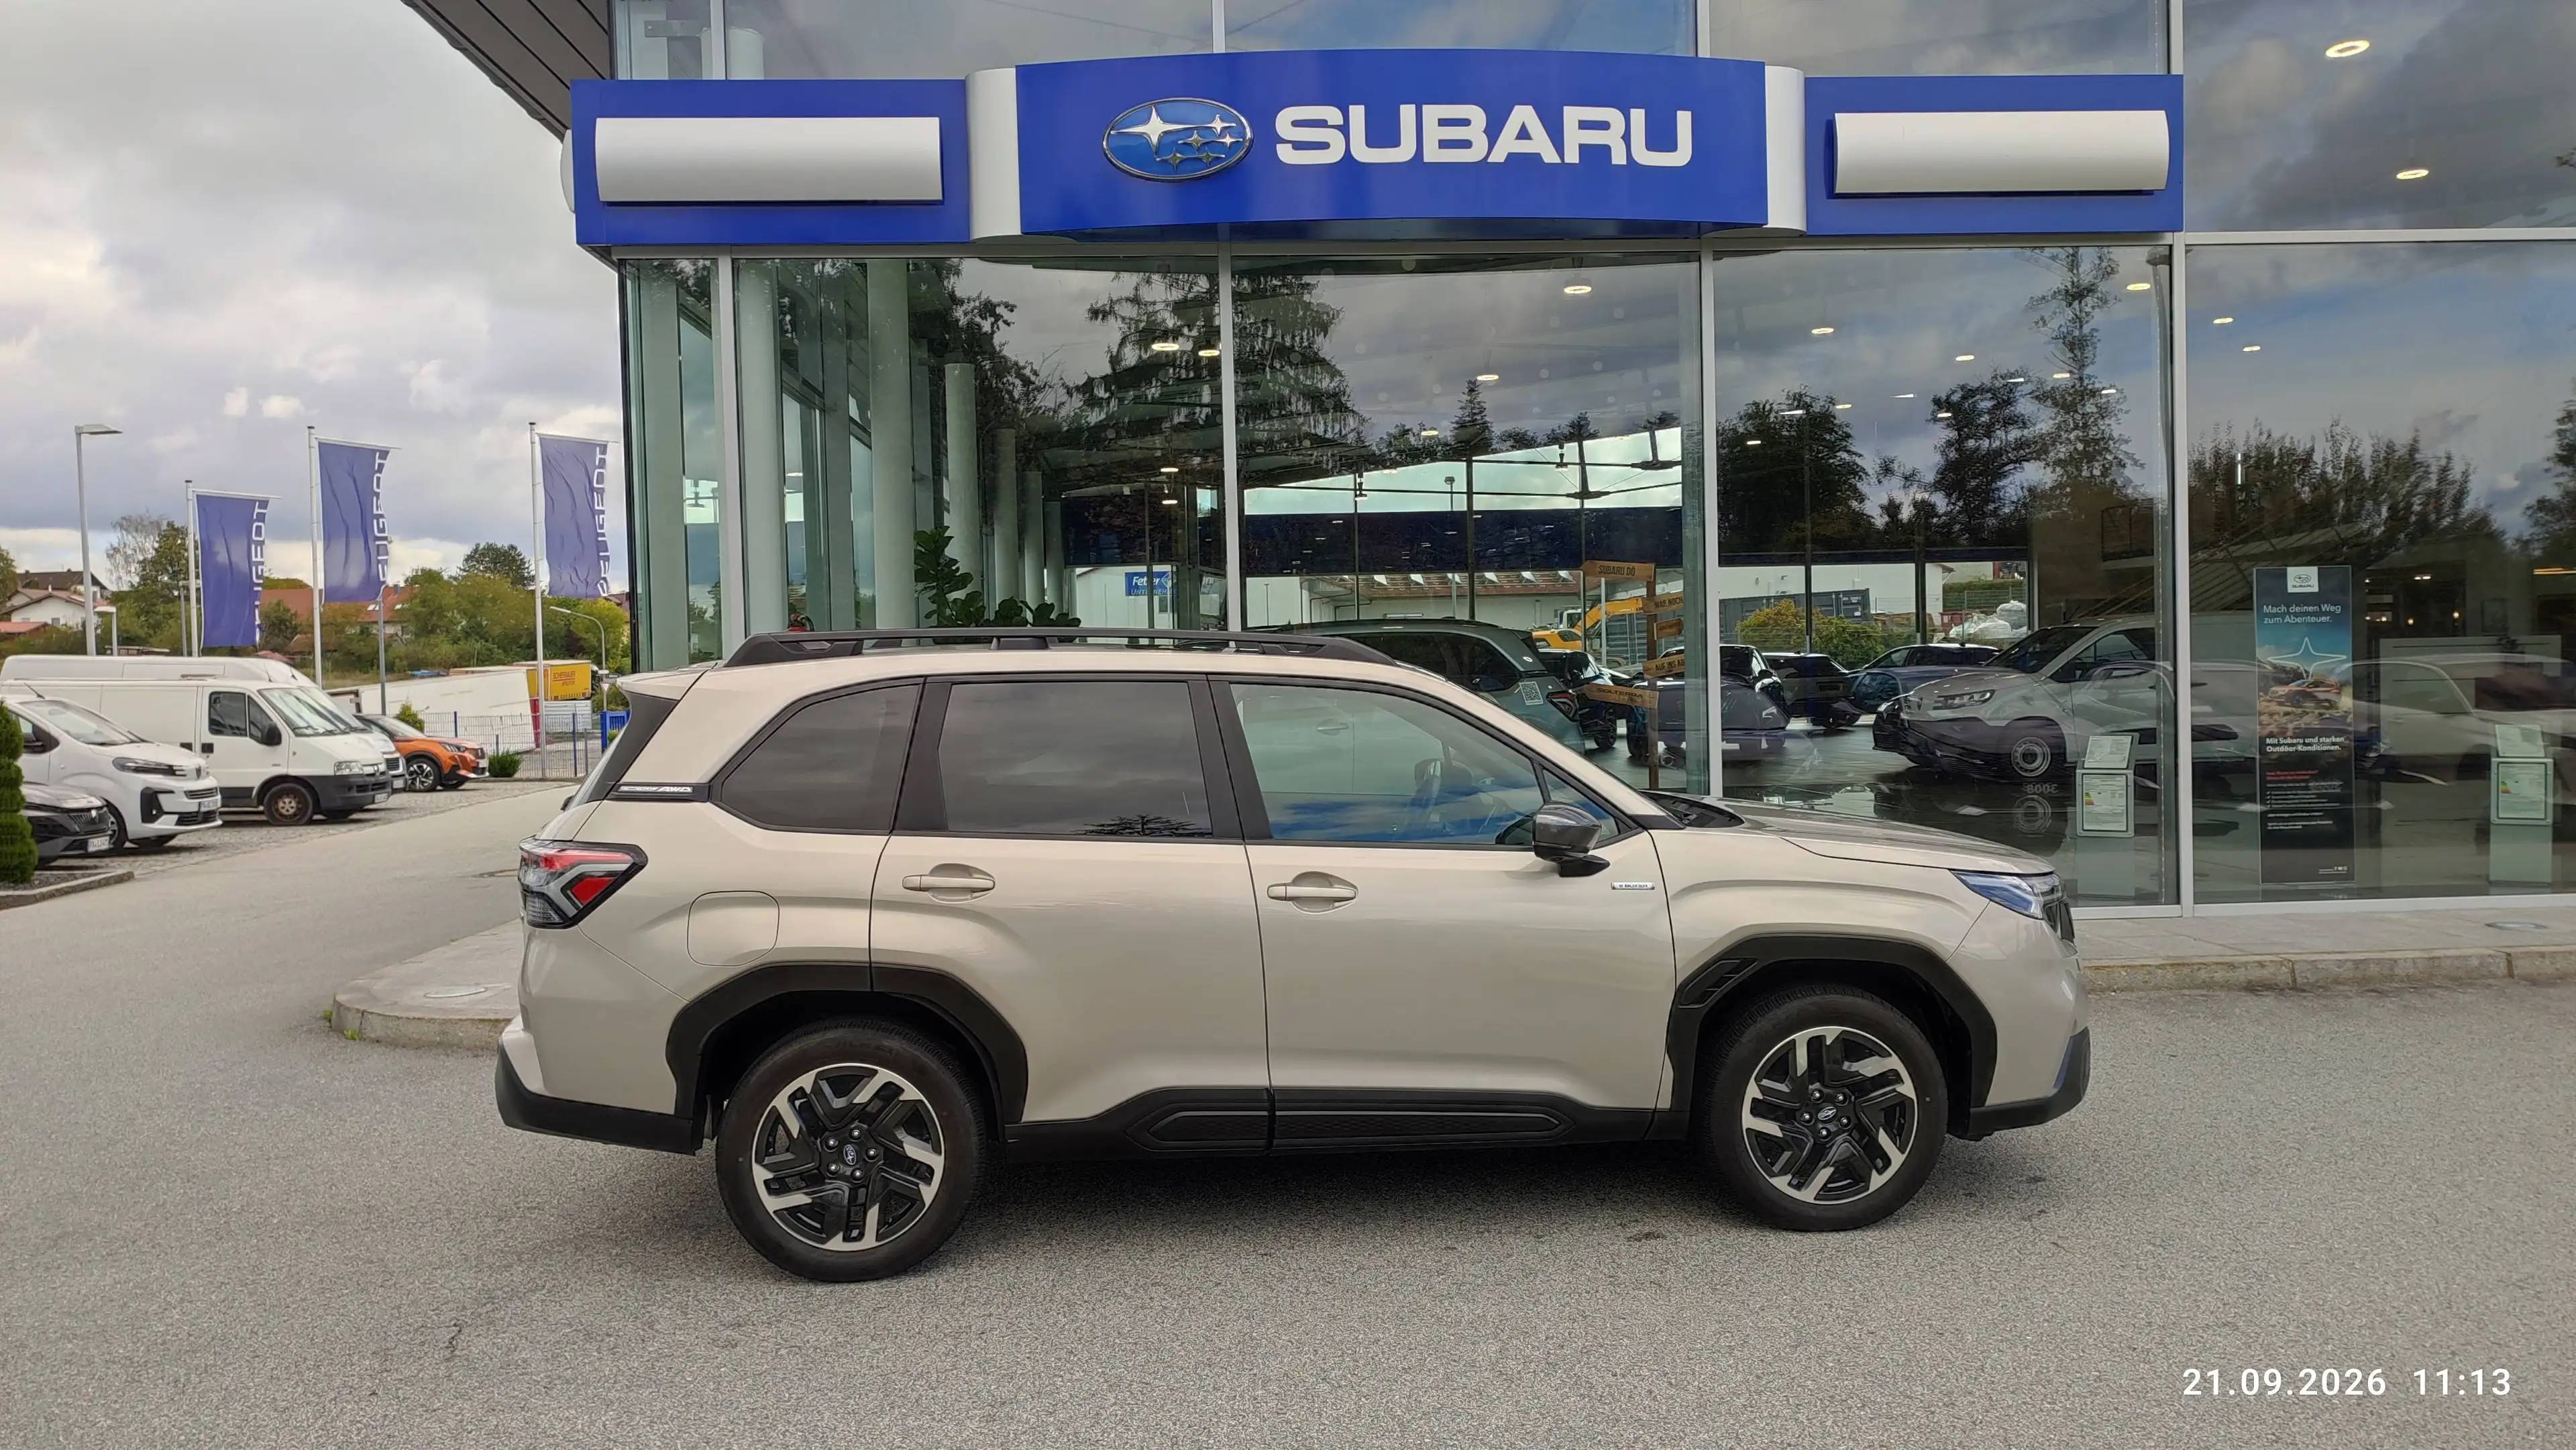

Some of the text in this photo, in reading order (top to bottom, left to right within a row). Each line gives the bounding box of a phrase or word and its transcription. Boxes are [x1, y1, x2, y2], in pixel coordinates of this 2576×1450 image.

[1275, 104, 1693, 167] SUBARU
[373, 452, 389, 582] EUGEOT
[1599, 565, 1624, 575] SUBARU
[2263, 604, 2341, 613] Mach deinen Weg
[2284, 615, 2332, 623] Abenteuer.
